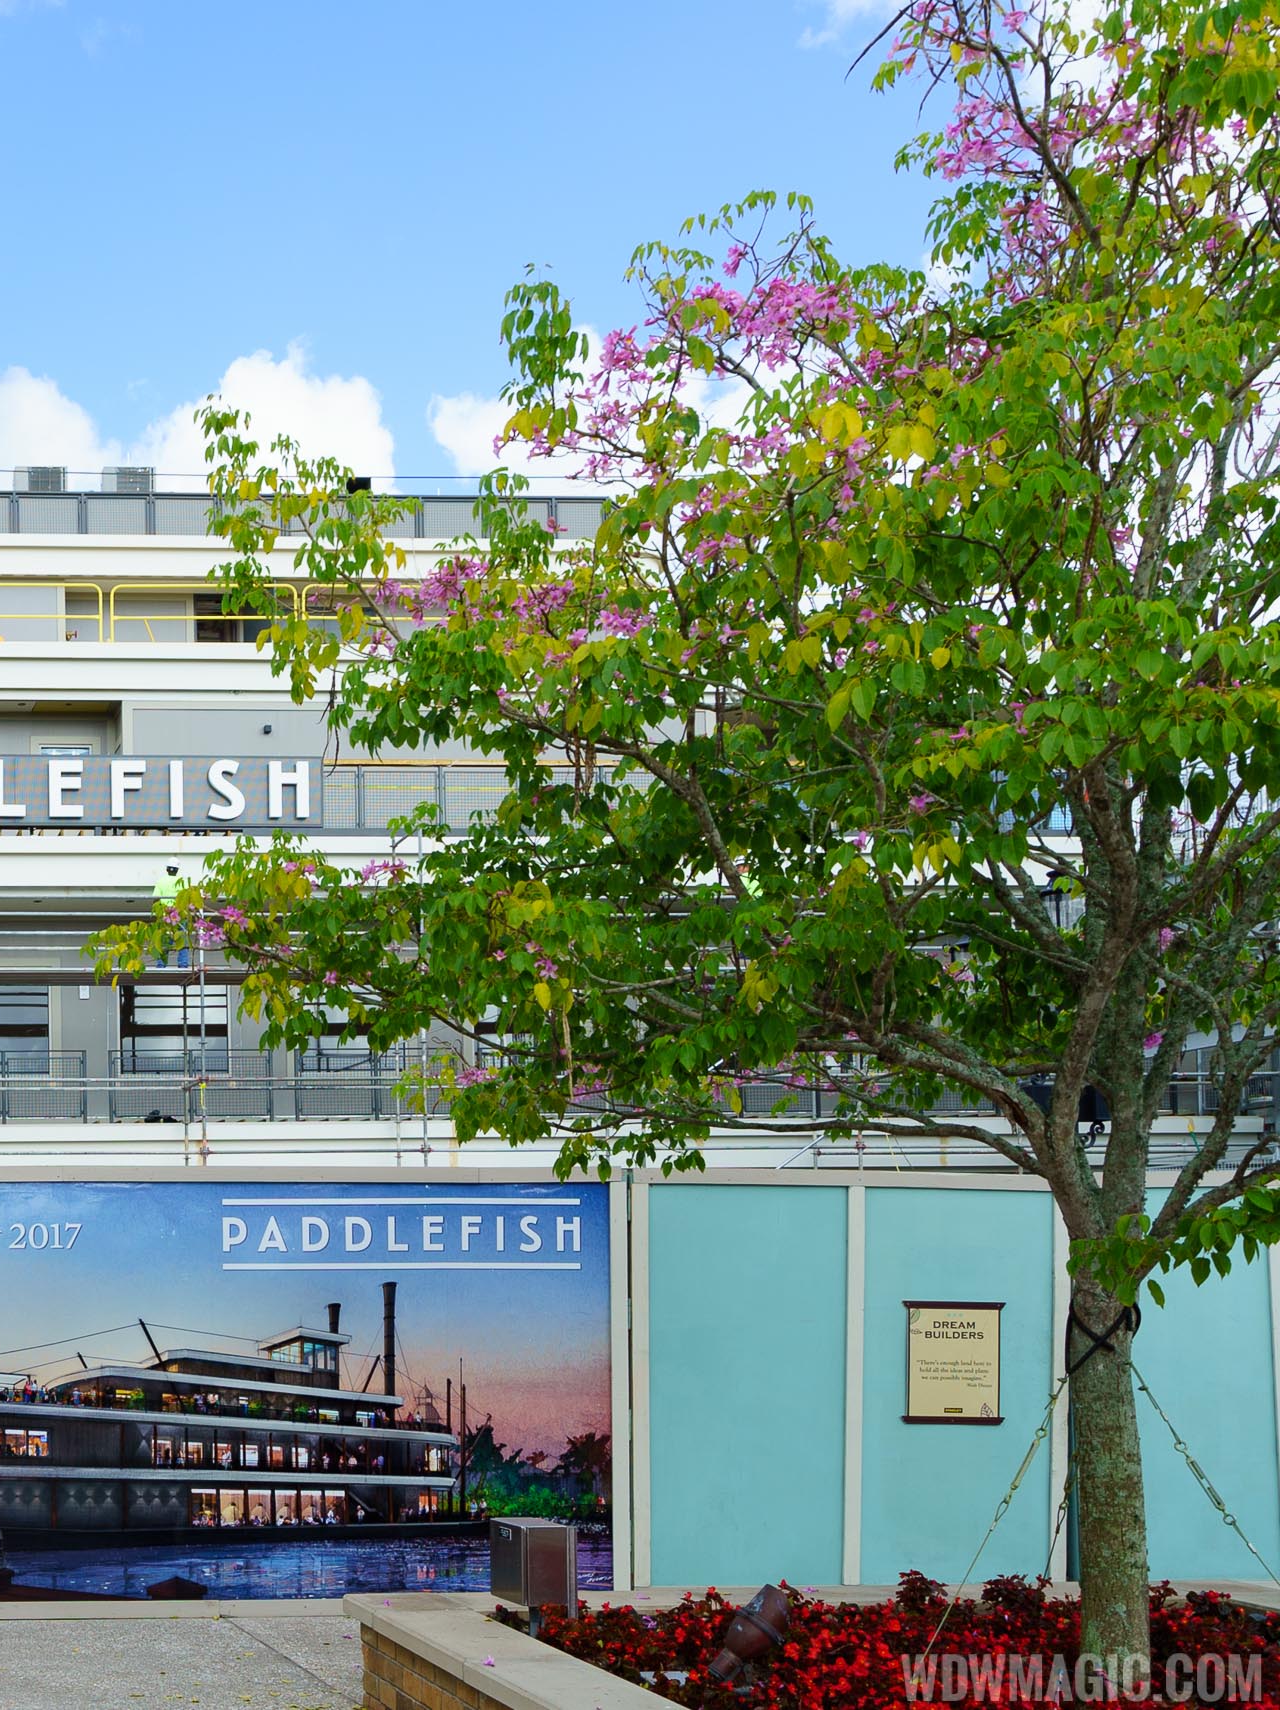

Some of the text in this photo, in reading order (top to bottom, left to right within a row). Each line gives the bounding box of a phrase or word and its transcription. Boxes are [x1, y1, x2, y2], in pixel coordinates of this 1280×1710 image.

[9, 1223, 84, 1250] 2017
[221, 1215, 581, 1252] PADDLEFISH
[933, 1321, 976, 1329] DREAM
[925, 1331, 984, 1339] BUILDERS
